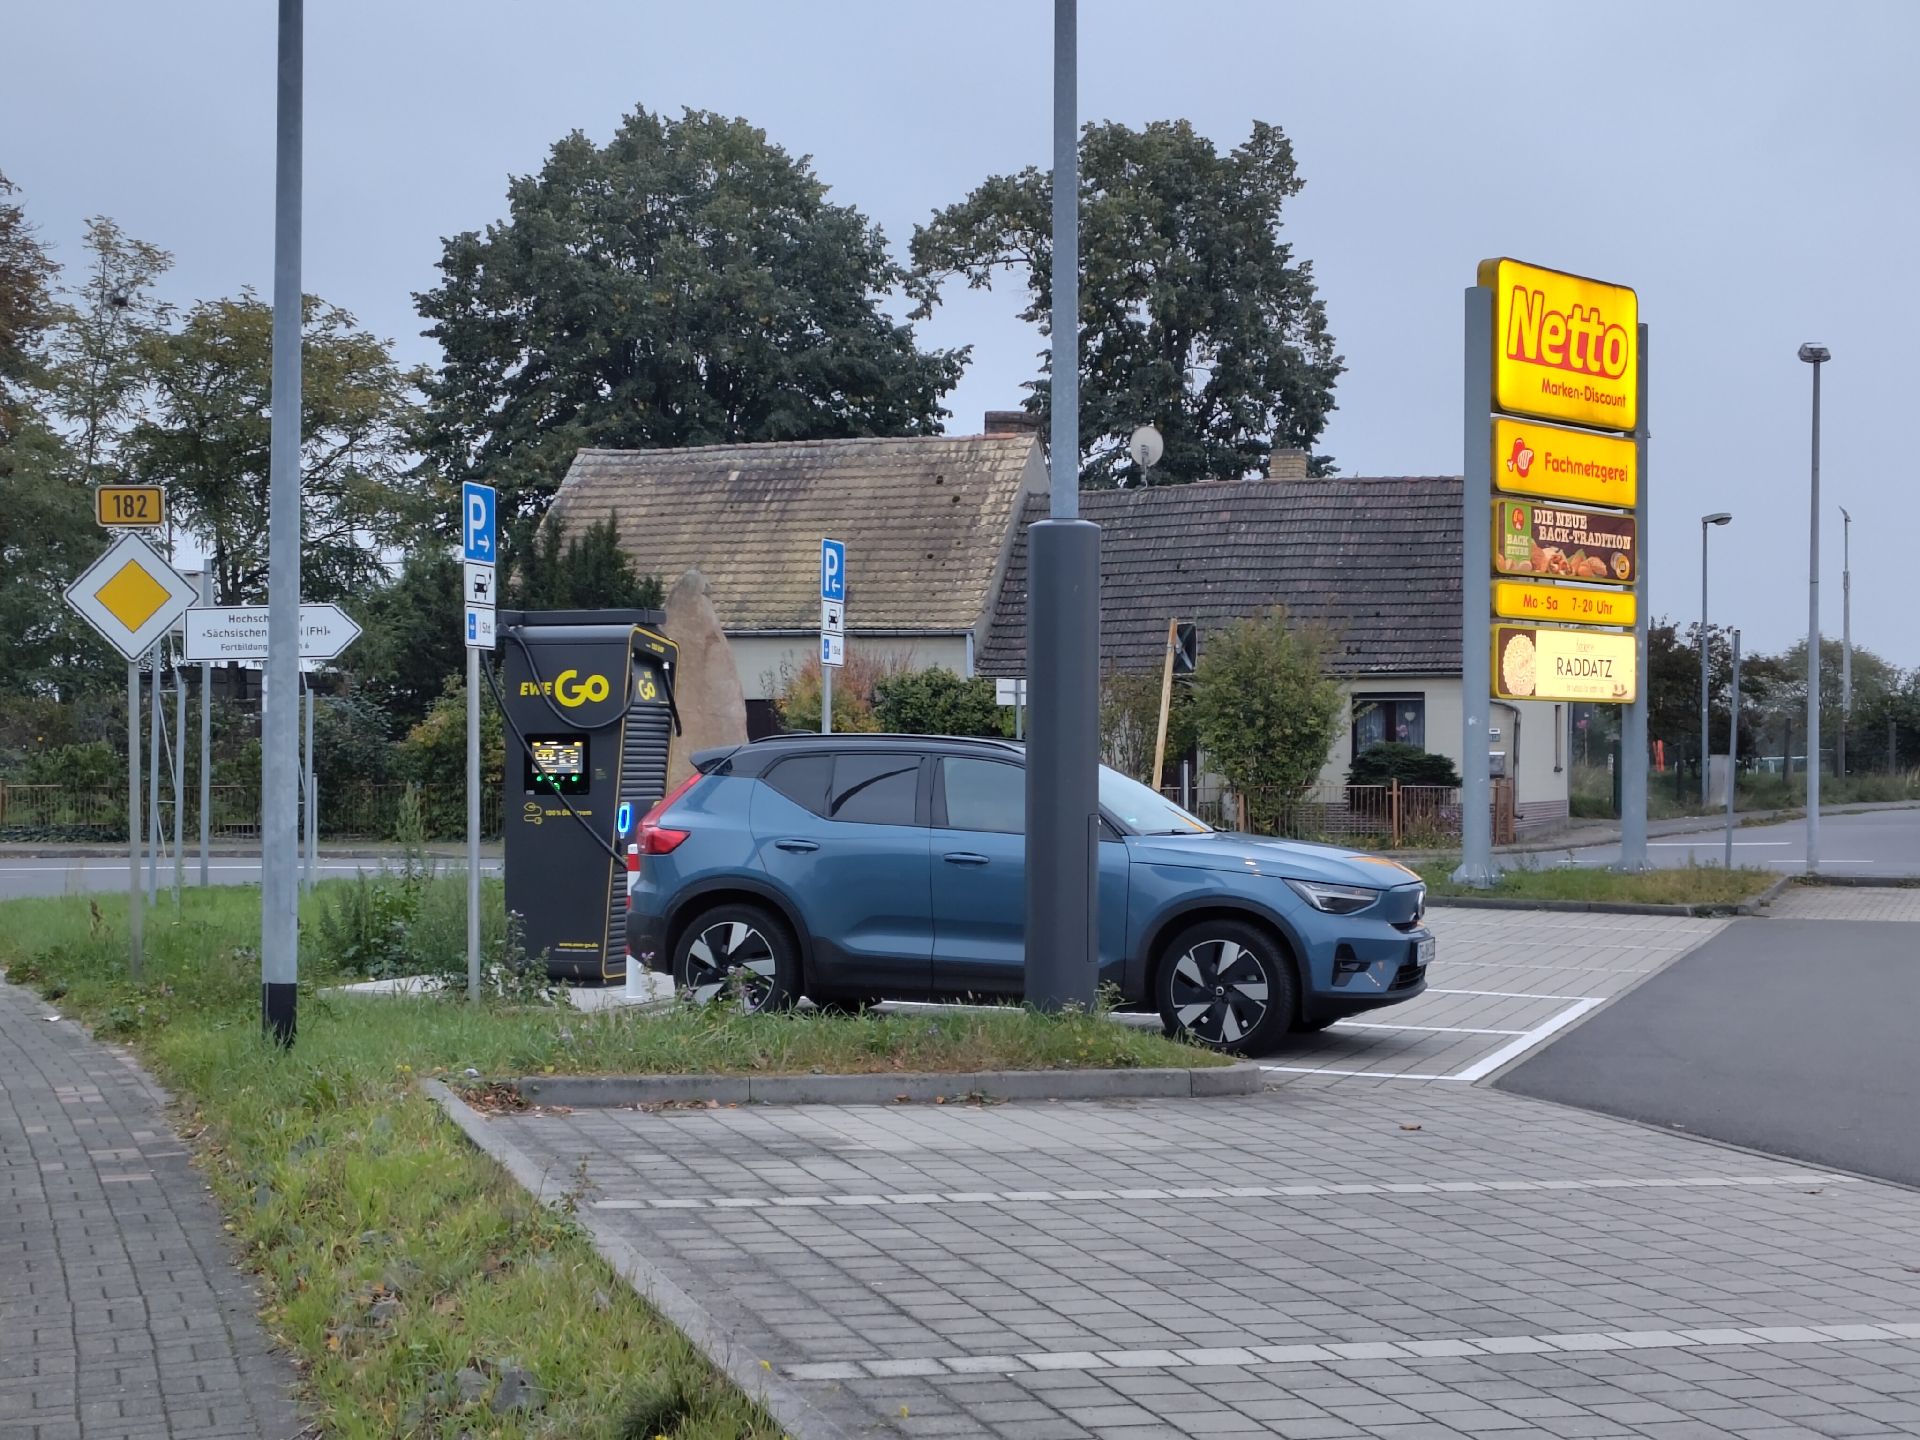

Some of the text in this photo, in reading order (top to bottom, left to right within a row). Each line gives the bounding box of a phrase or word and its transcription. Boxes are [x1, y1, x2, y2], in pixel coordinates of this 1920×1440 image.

[1506, 284, 1629, 380] Netto
[1541, 377, 1627, 408] Marken-Discount
[1544, 451, 1628, 483] Fachmetzgerei
[112, 494, 148, 518] 182
[468, 493, 487, 550] P
[1533, 509, 1588, 530] DIE NEUE
[1538, 525, 1632, 550] BACK-TRADITION
[825, 547, 838, 592] P
[1522, 593, 1539, 609] Mo
[1546, 596, 1559, 610] Sa
[1596, 600, 1614, 615] Uhr
[1556, 657, 1613, 678] RADDATZ
[519, 681, 553, 696] EWE
